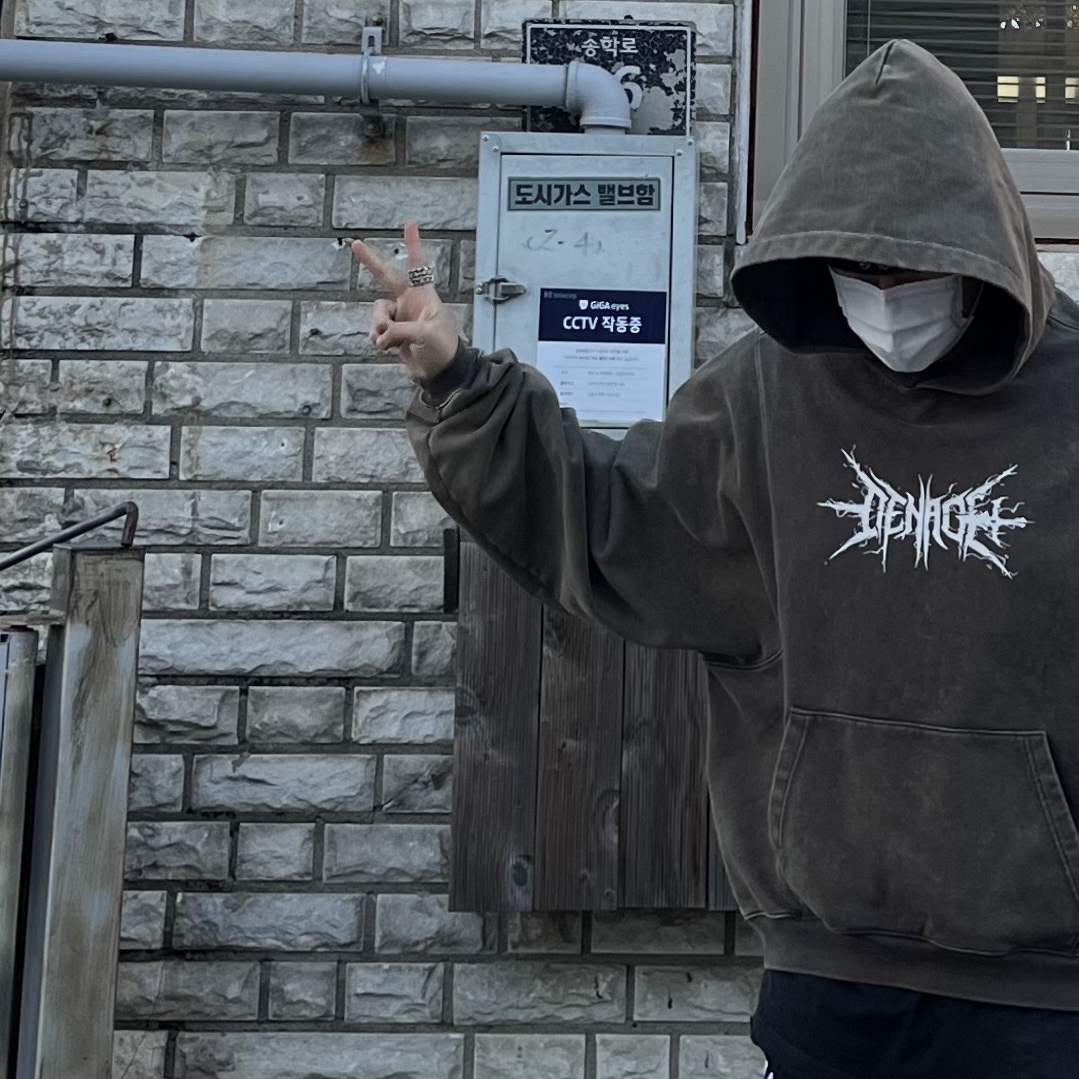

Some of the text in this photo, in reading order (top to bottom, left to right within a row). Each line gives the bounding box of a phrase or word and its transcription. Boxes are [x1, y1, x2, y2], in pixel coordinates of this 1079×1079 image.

[581, 36, 639, 57] 송학로
[515, 184, 655, 206] 도시가스 밸브함
[563, 316, 642, 333] CCTV 작동중
